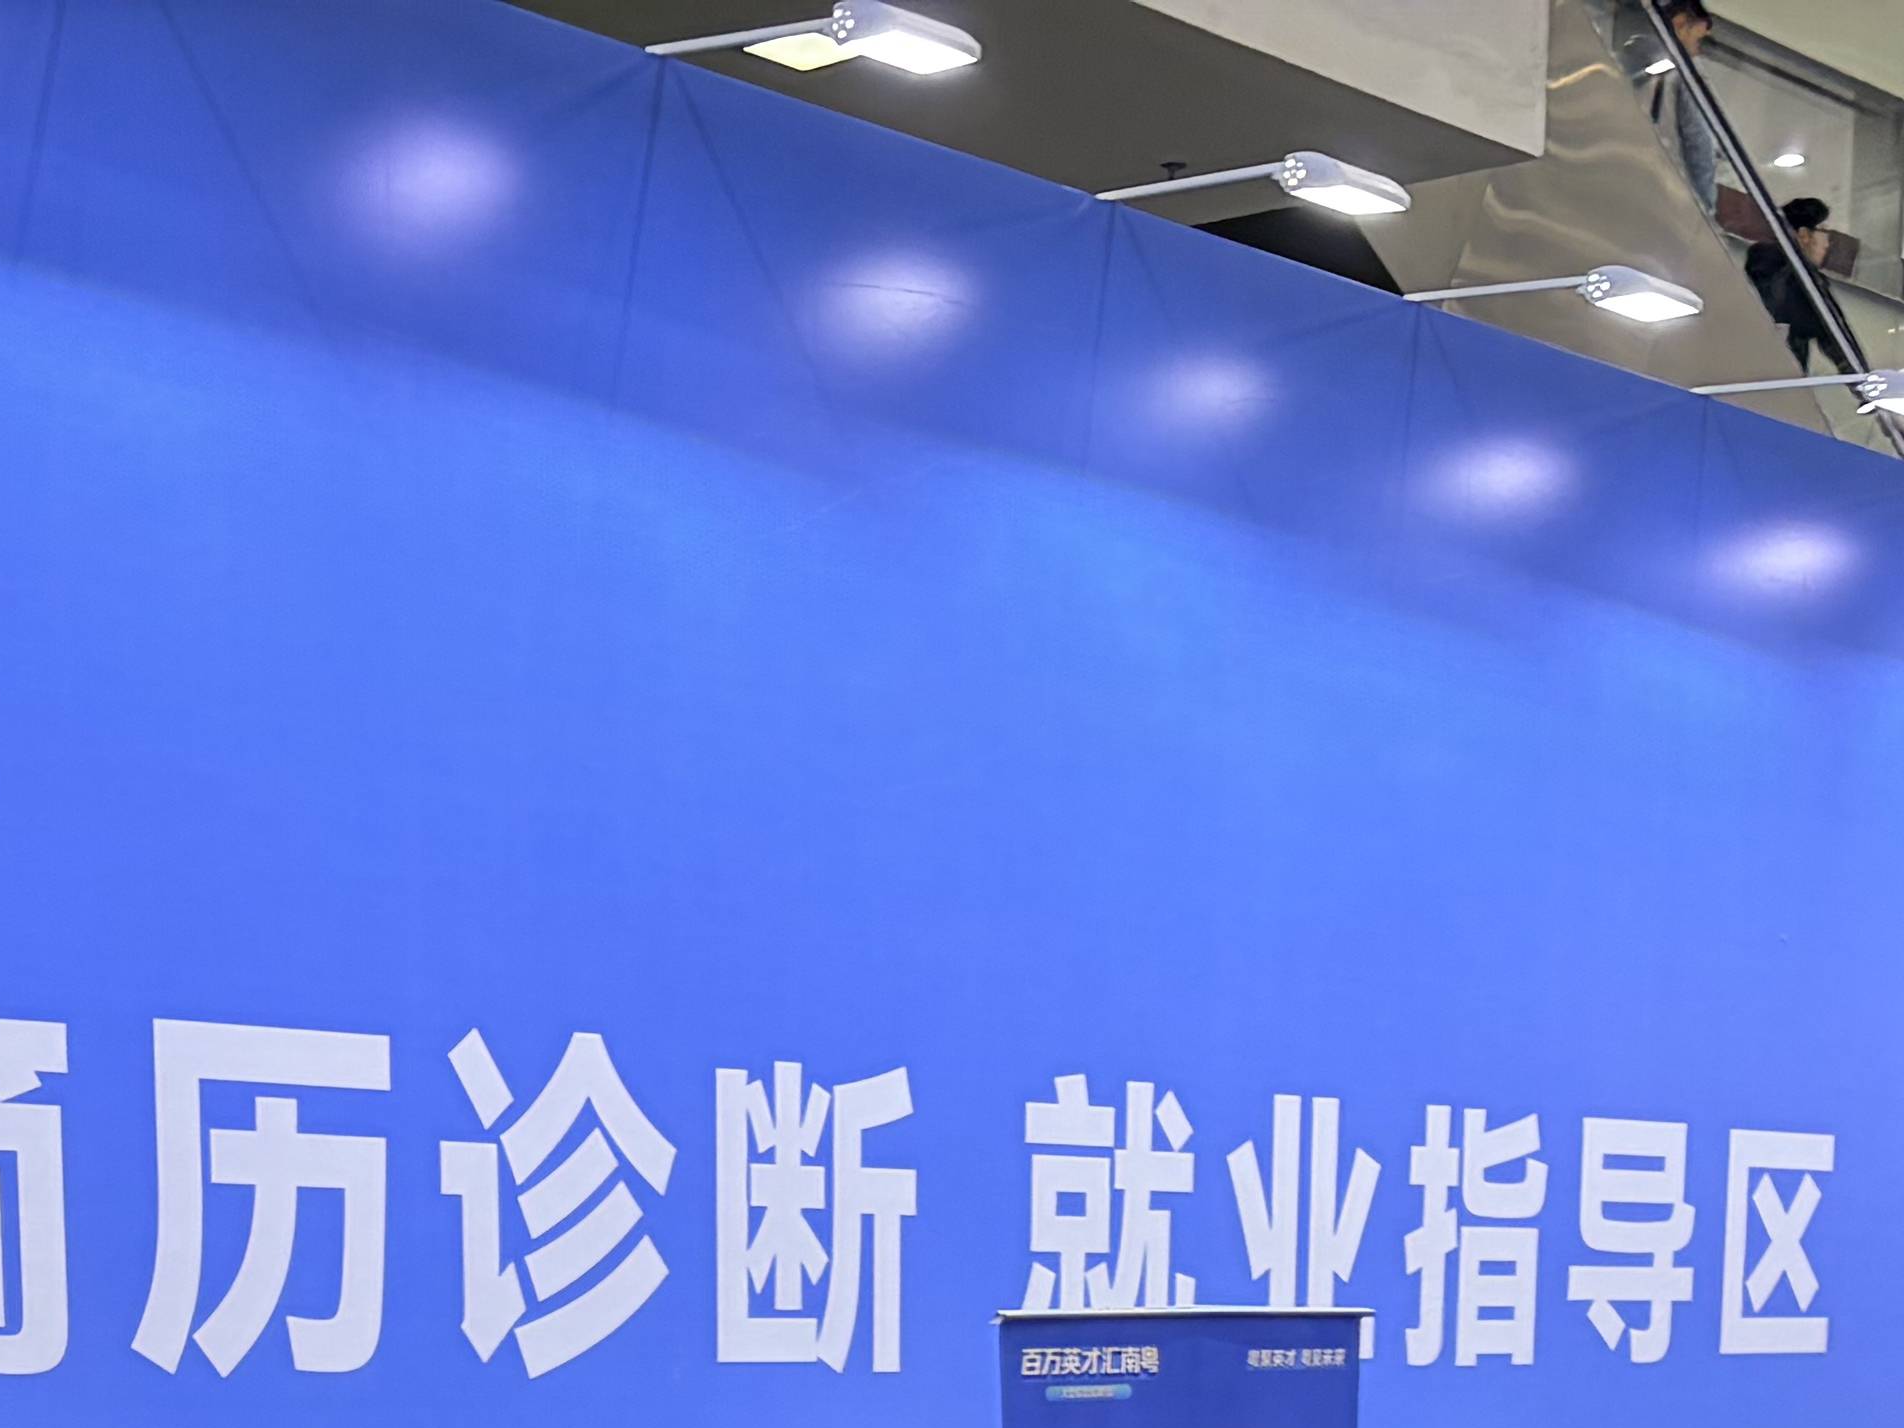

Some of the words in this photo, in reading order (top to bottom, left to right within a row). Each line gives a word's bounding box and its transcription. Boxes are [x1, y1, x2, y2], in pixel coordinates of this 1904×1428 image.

[1022, 1073, 1835, 1367] 就业指导区
[1020, 1346, 1160, 1376] 百万英才汇南粤
